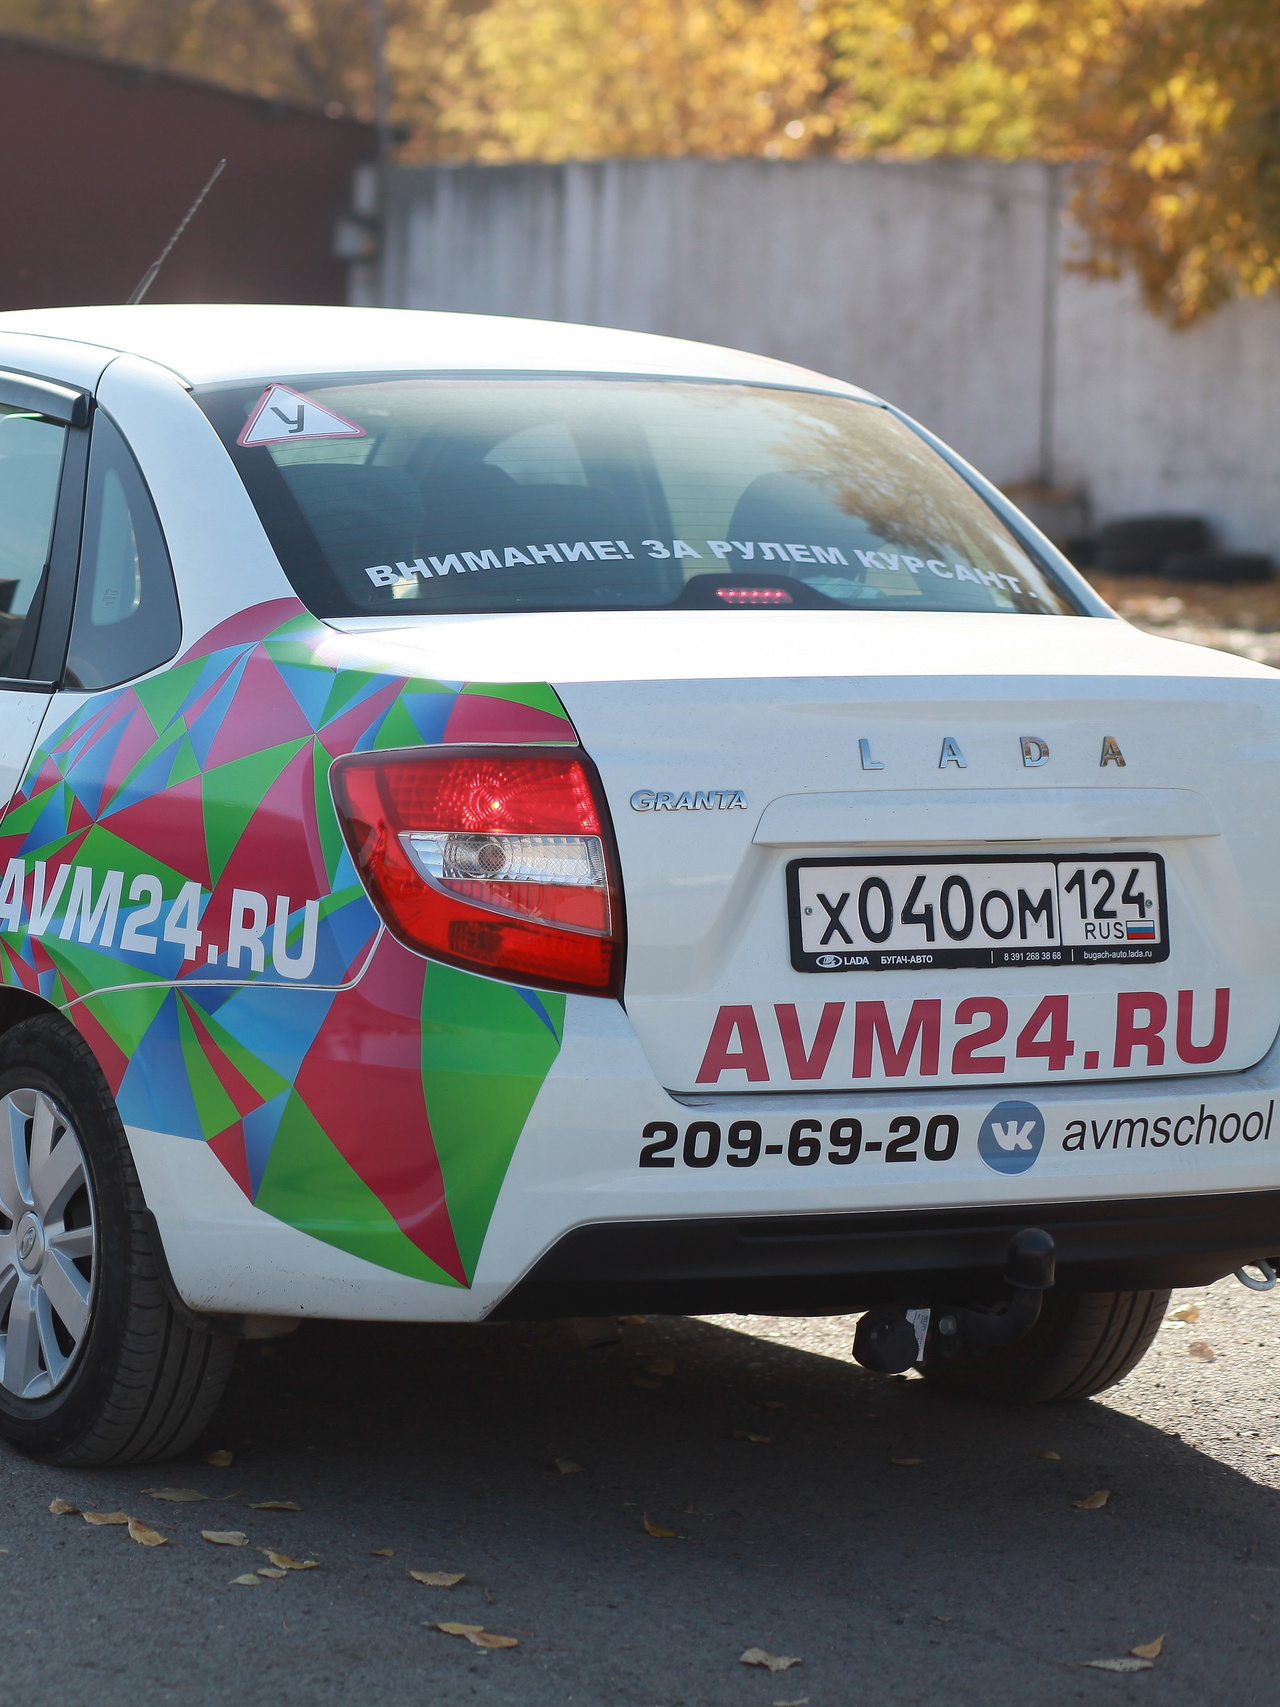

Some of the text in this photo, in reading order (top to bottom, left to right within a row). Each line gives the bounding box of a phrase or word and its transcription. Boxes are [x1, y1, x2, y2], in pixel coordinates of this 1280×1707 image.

[270, 404, 305, 434] У
[364, 540, 635, 588] ВНИМАНИЕ!
[641, 539, 702, 560] ЗА
[706, 540, 849, 567] РУЛЕМ
[858, 735, 1128, 771] LADA
[630, 787, 749, 813] GRANTA
[1063, 868, 1147, 920] 124
[1083, 921, 1125, 941] RUS
[843, 955, 870, 966] LADA
[880, 953, 934, 966] БУГАЧ-АВТО
[1004, 951, 1061, 961] 8 391 268 38 68
[1083, 949, 1153, 960] bugach-auto.lada.ru
[695, 987, 1231, 1085] AVM24.RU
[638, 1113, 960, 1169] 209-69-20
[1061, 1100, 1275, 1152] avmschool
